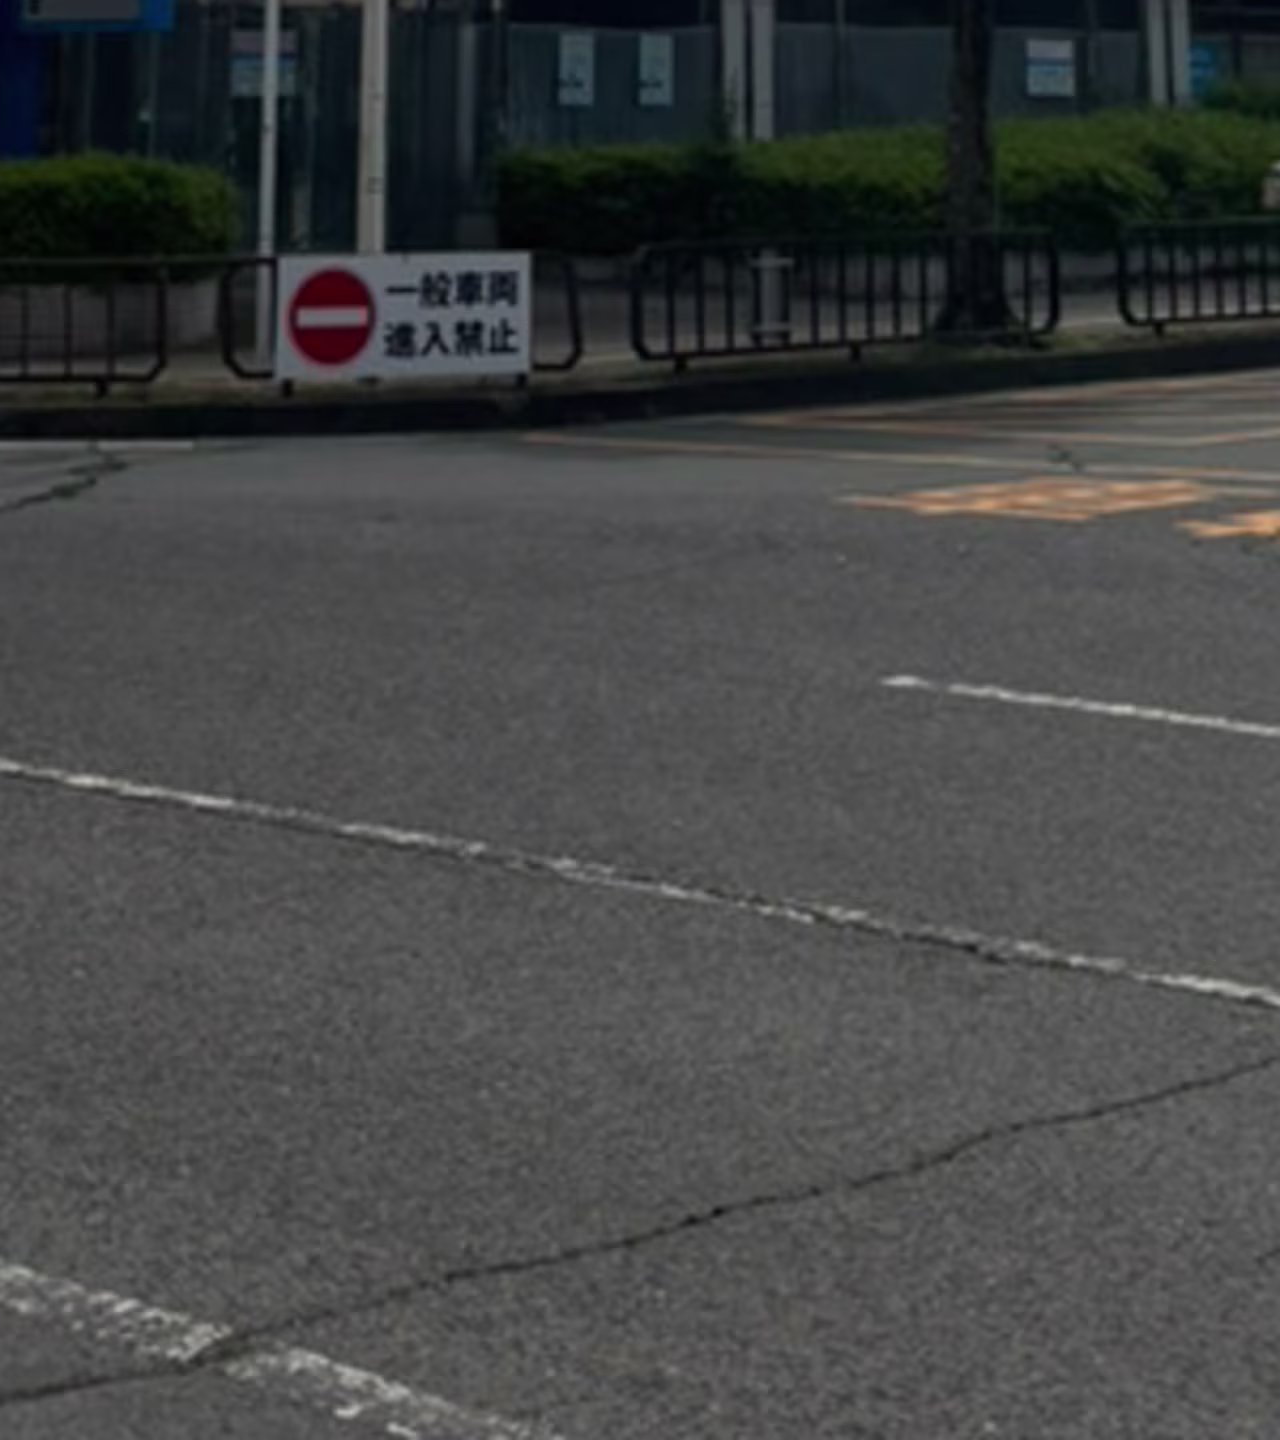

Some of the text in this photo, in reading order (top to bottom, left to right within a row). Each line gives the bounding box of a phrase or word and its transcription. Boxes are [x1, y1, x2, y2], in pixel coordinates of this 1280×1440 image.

[385, 269, 520, 308] 一般車両
[383, 317, 520, 358] 進入禁止
